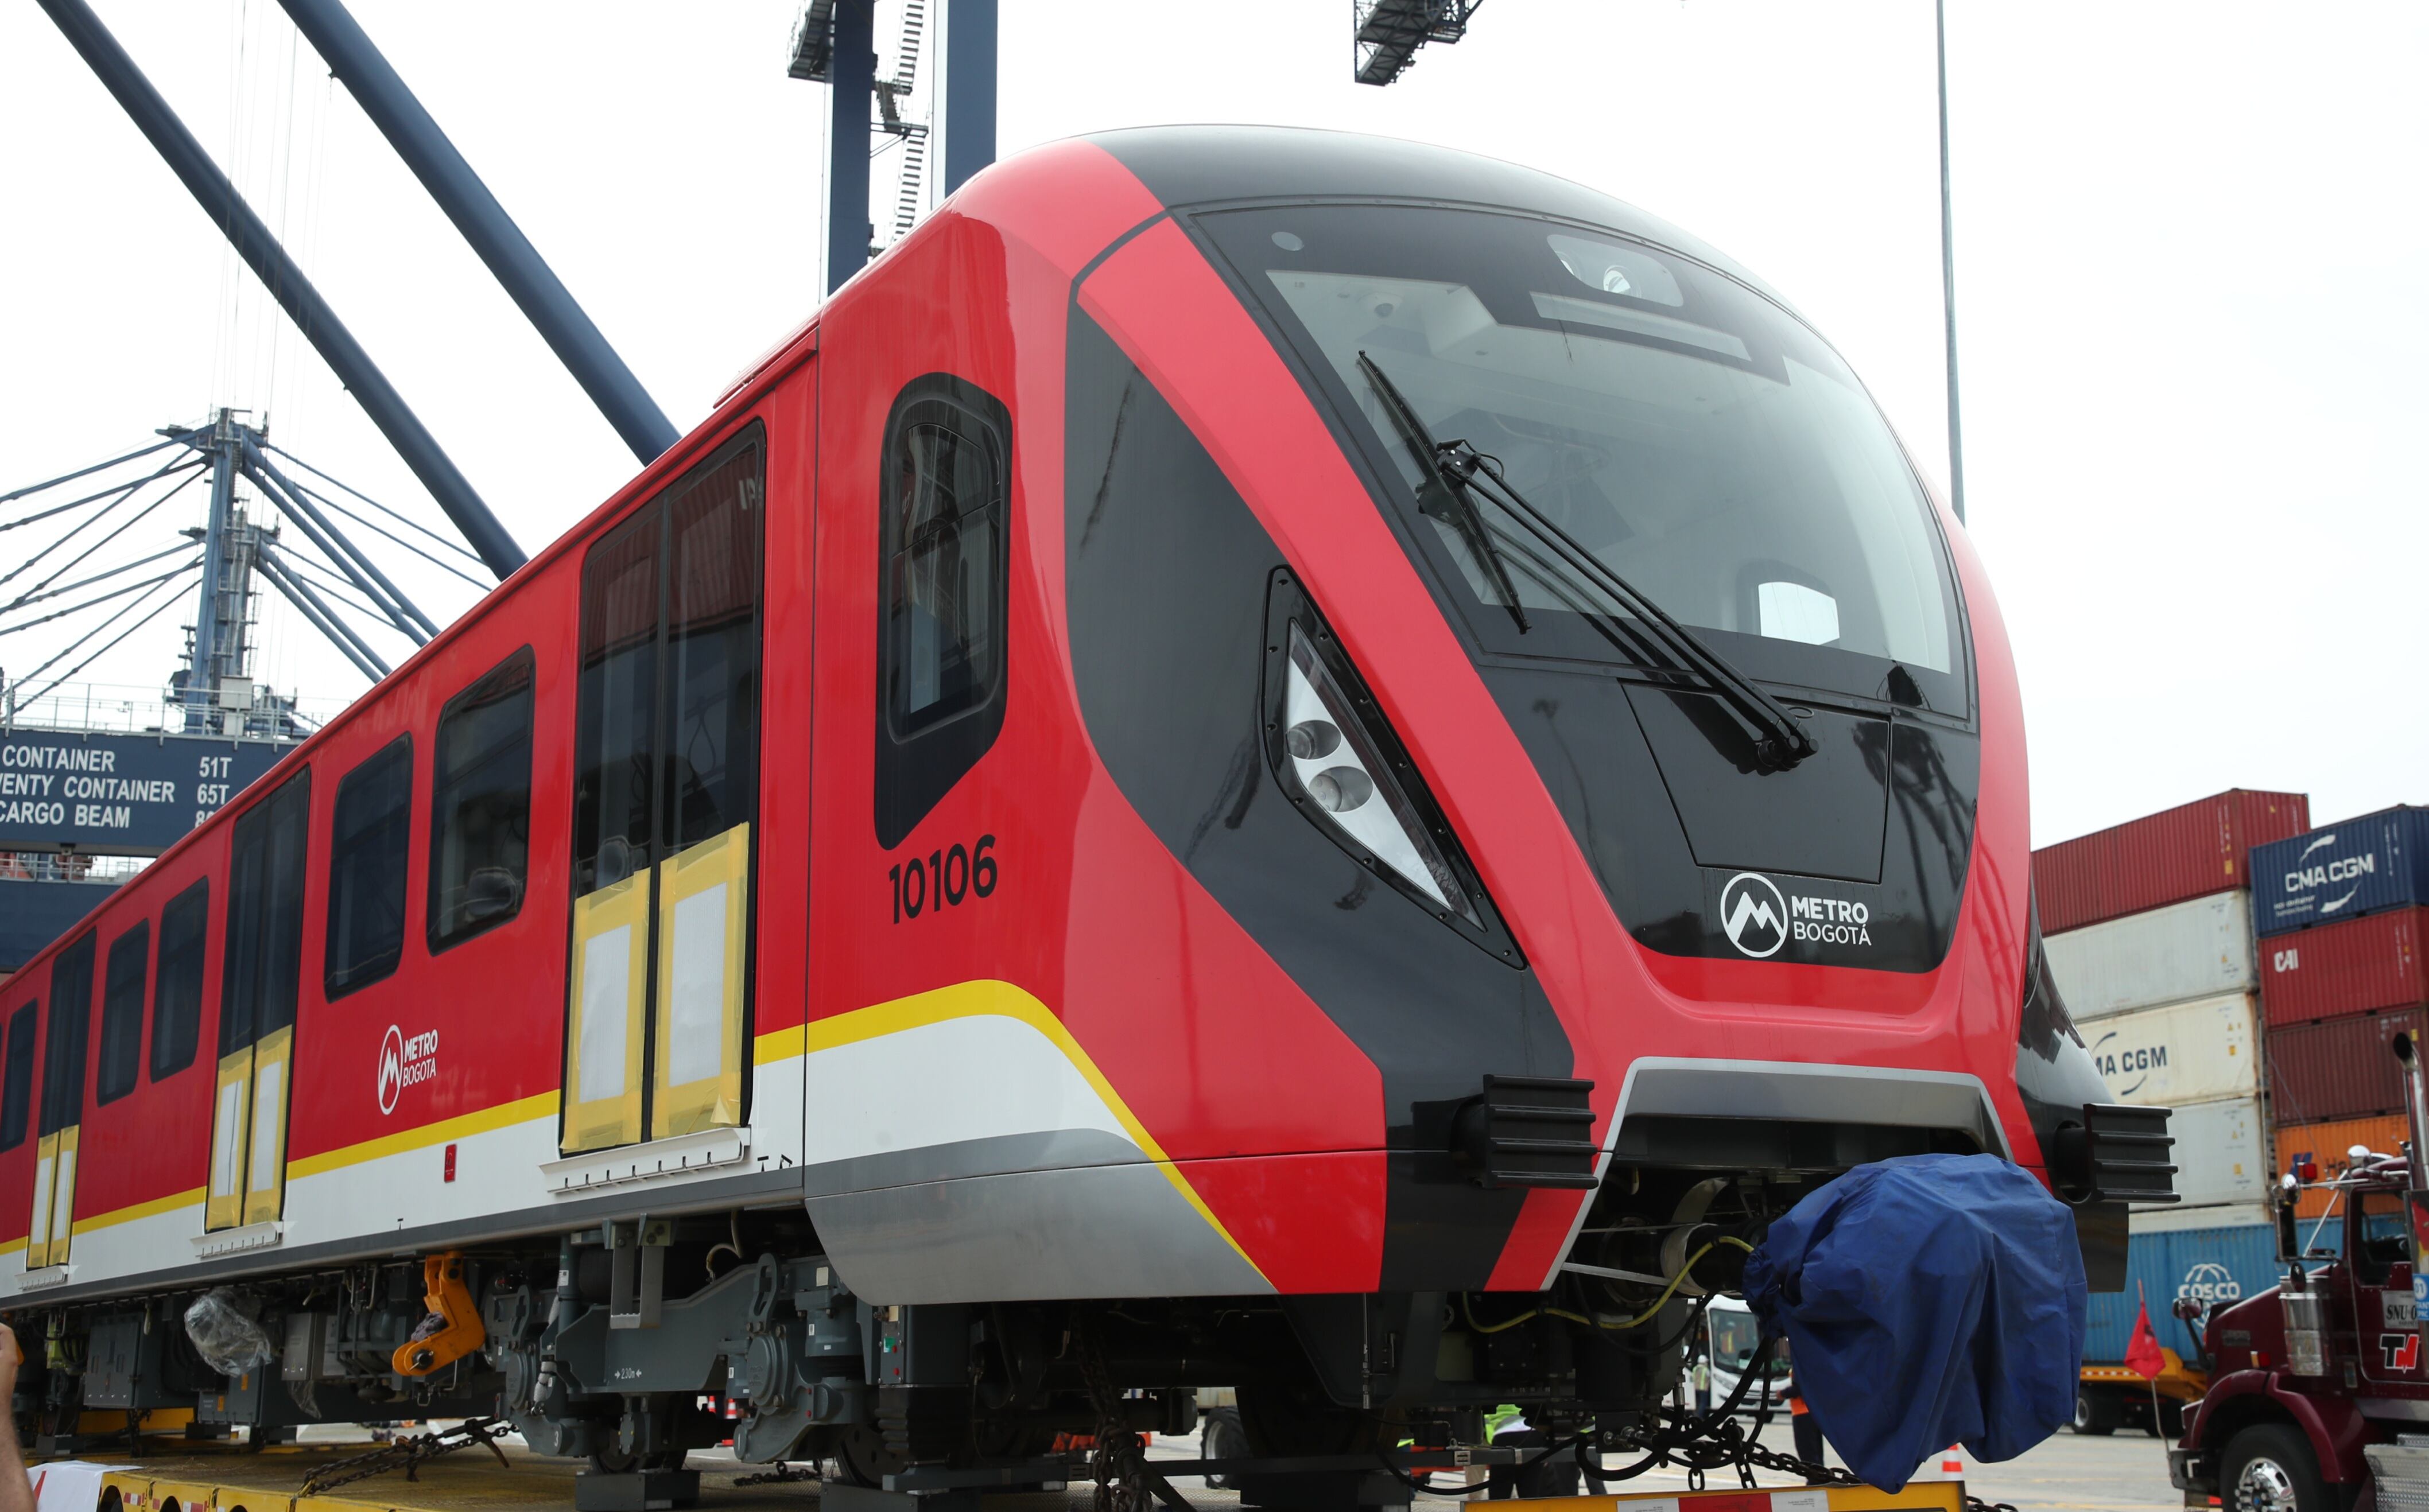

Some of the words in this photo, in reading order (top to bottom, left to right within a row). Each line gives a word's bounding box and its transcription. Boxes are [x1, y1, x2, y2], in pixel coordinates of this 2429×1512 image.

[2, 745, 115, 772] CONTAINER
[199, 756, 232, 779] 51T
[64, 776, 175, 803] CONTAINER
[197, 783, 230, 805] 65T
[75, 804, 130, 829] BEAM
[889, 834, 998, 924] 10106
[2285, 866, 2327, 892] CMA
[2328, 853, 2374, 882] CGM
[1791, 896, 1869, 924] METRO
[1794, 921, 1872, 946] BOGOTÁ
[2274, 948, 2299, 973] CAI
[404, 1029, 438, 1063] METRO
[2123, 1045, 2167, 1072] CGM
[2178, 1281, 2240, 1300] COSCO
